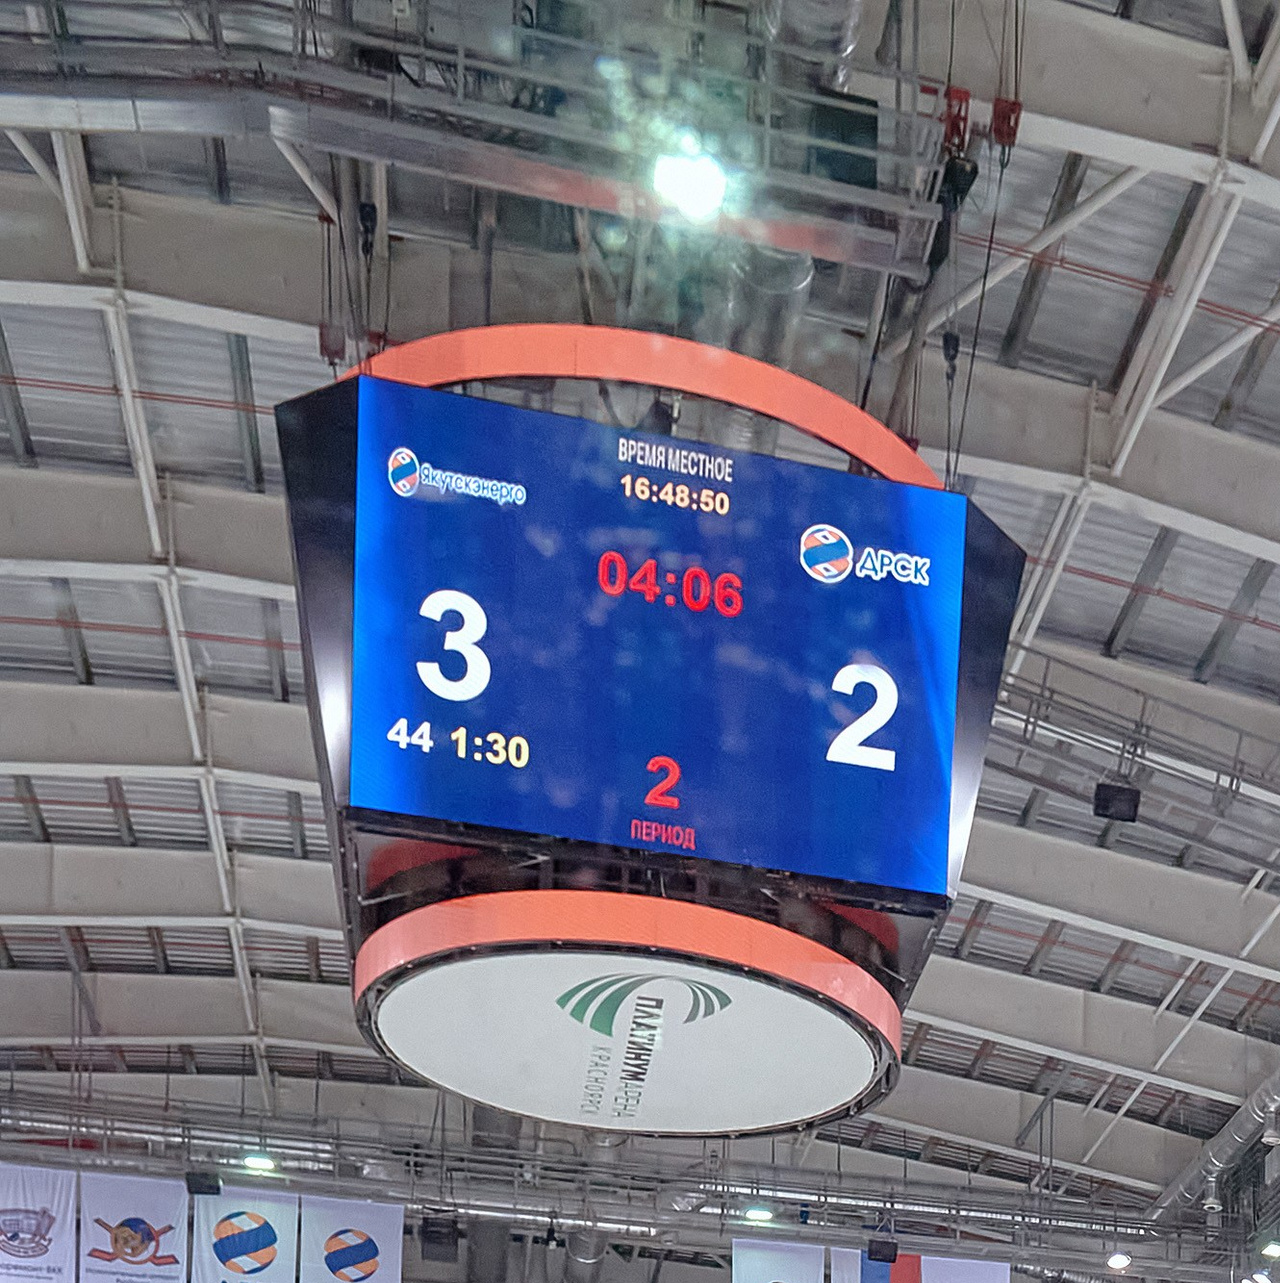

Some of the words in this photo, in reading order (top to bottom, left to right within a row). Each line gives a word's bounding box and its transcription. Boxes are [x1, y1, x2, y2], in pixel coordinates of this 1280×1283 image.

[618, 437, 666, 467] ВРЕМЯ
[666, 451, 734, 483] МЕСТНОЕ
[420, 463, 526, 506] Якутскэнерго
[621, 474, 730, 516] 16:48:50
[598, 551, 744, 617] 04:06
[855, 551, 930, 585] ДРСК
[416, 590, 492, 701] 3
[826, 664, 900, 771] 2
[387, 718, 434, 753] 44
[450, 730, 530, 768] 1:30
[645, 756, 680, 809] 2
[630, 819, 696, 850] ПЕРИОД
